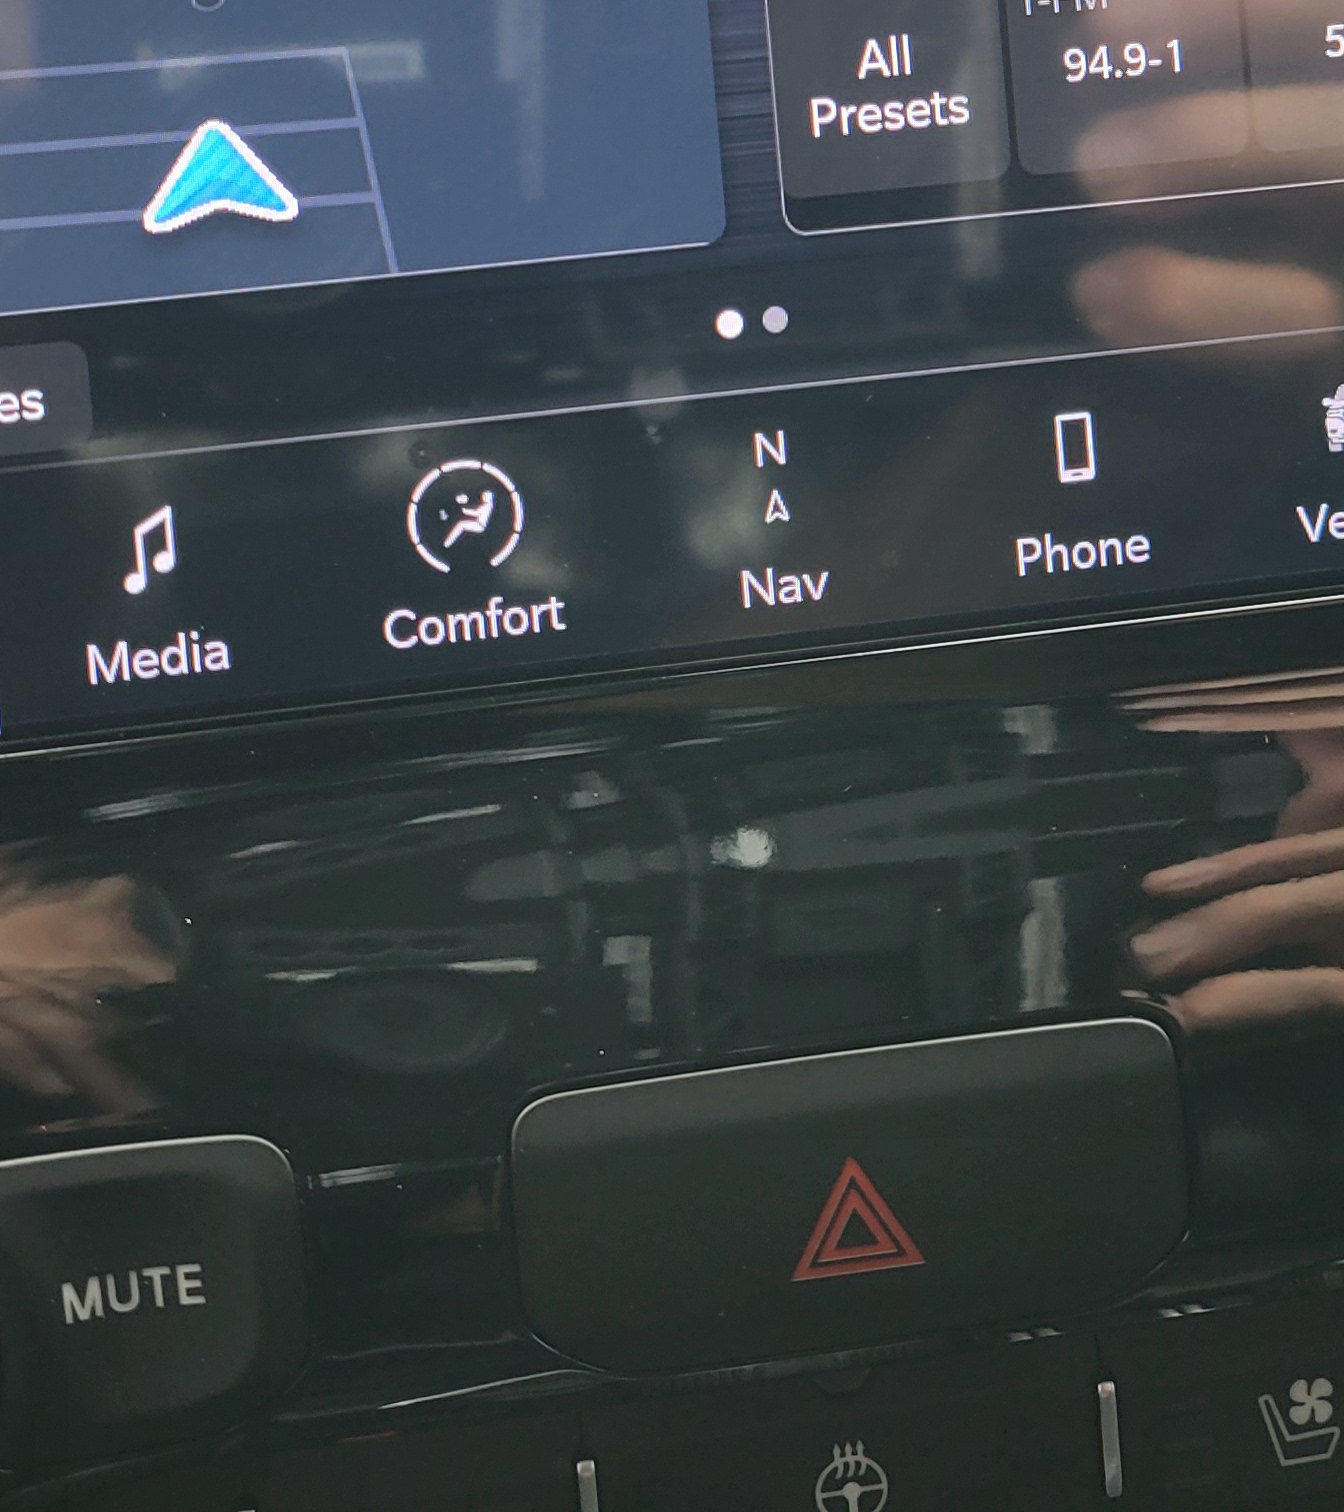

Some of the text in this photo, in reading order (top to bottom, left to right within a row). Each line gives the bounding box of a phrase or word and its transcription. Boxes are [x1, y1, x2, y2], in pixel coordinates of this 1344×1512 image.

[857, 33, 913, 78] All
[1061, 39, 1184, 84] 94.9-1
[809, 89, 970, 139] Presets
[1015, 531, 1152, 577] Phone
[740, 567, 829, 609] Nav
[383, 594, 567, 651] Comfort
[86, 629, 231, 686] Media
[60, 1262, 207, 1325] MUTE
